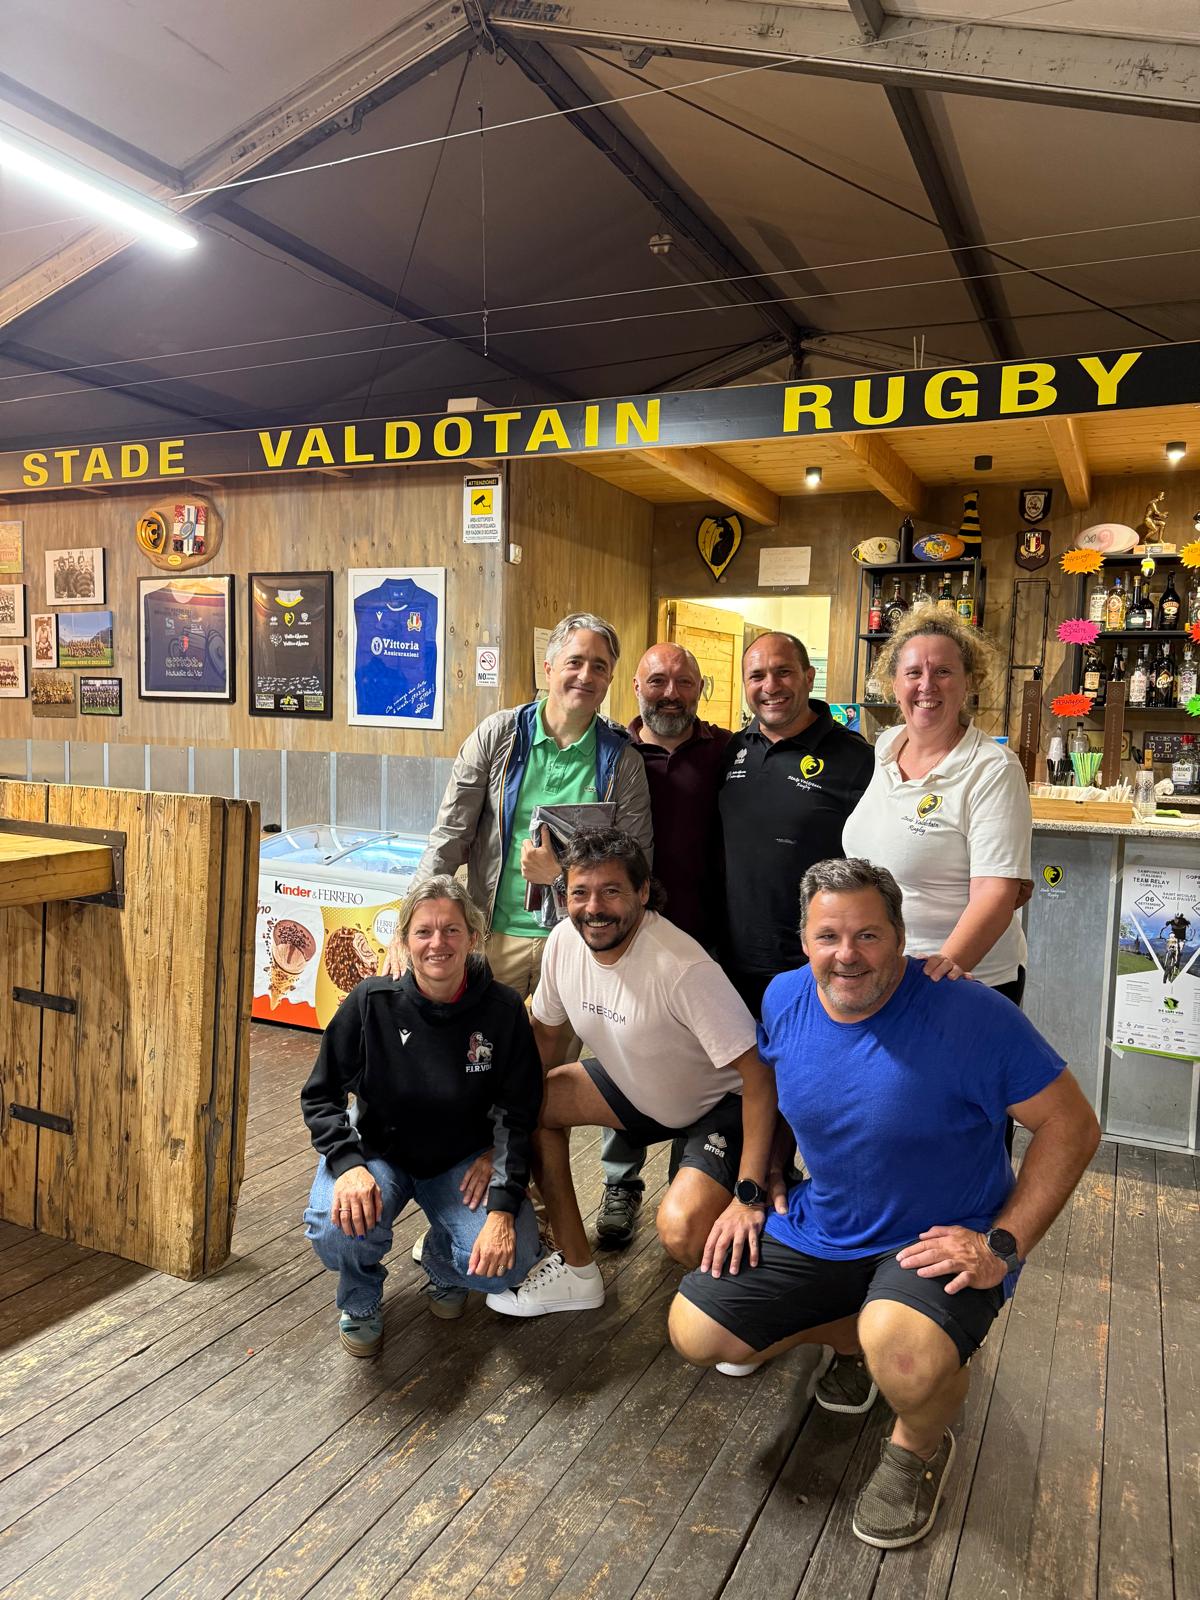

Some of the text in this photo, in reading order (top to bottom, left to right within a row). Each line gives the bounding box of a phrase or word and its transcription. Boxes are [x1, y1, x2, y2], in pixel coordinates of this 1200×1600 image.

[23, 352, 1142, 487] STADE VALDOTAIN RUGBY
[382, 638, 420, 650] Vittoria
[478, 672, 486, 680] NO
[312, 890, 317, 899] &
[318, 889, 364, 905] FERRERO
[582, 1001, 626, 1026] FREEDOM
